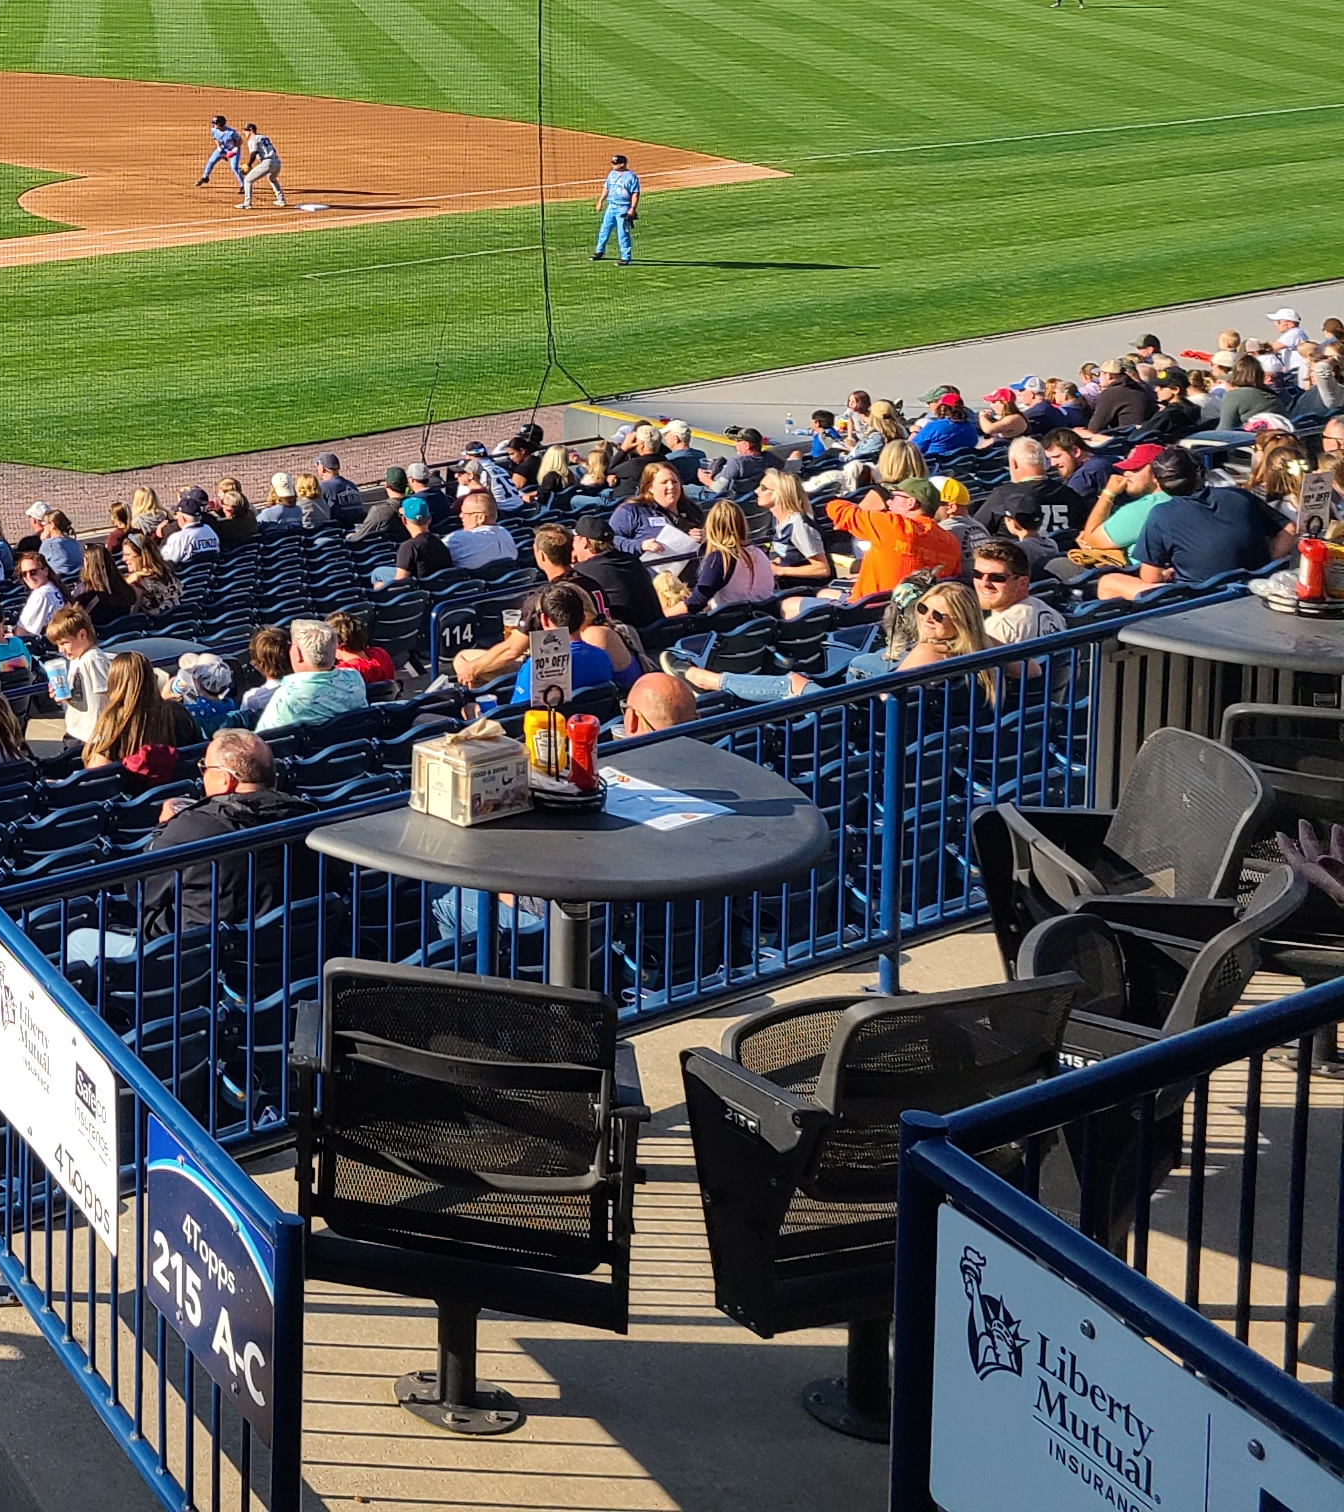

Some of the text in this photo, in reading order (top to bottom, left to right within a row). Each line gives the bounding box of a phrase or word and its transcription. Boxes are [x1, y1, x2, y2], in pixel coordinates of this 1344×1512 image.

[442, 623, 473, 648] 114
[551, 653, 570, 668] OFF!
[18, 1001, 51, 1050] Liberty
[75, 1061, 107, 1125] Safeco
[53, 1143, 110, 1235] 4Topps
[182, 1213, 236, 1294] 4Topps
[152, 1229, 267, 1407] 215 A-C
[1036, 1330, 1155, 1456] Liberty
[1032, 1374, 1154, 1500] Mutual
